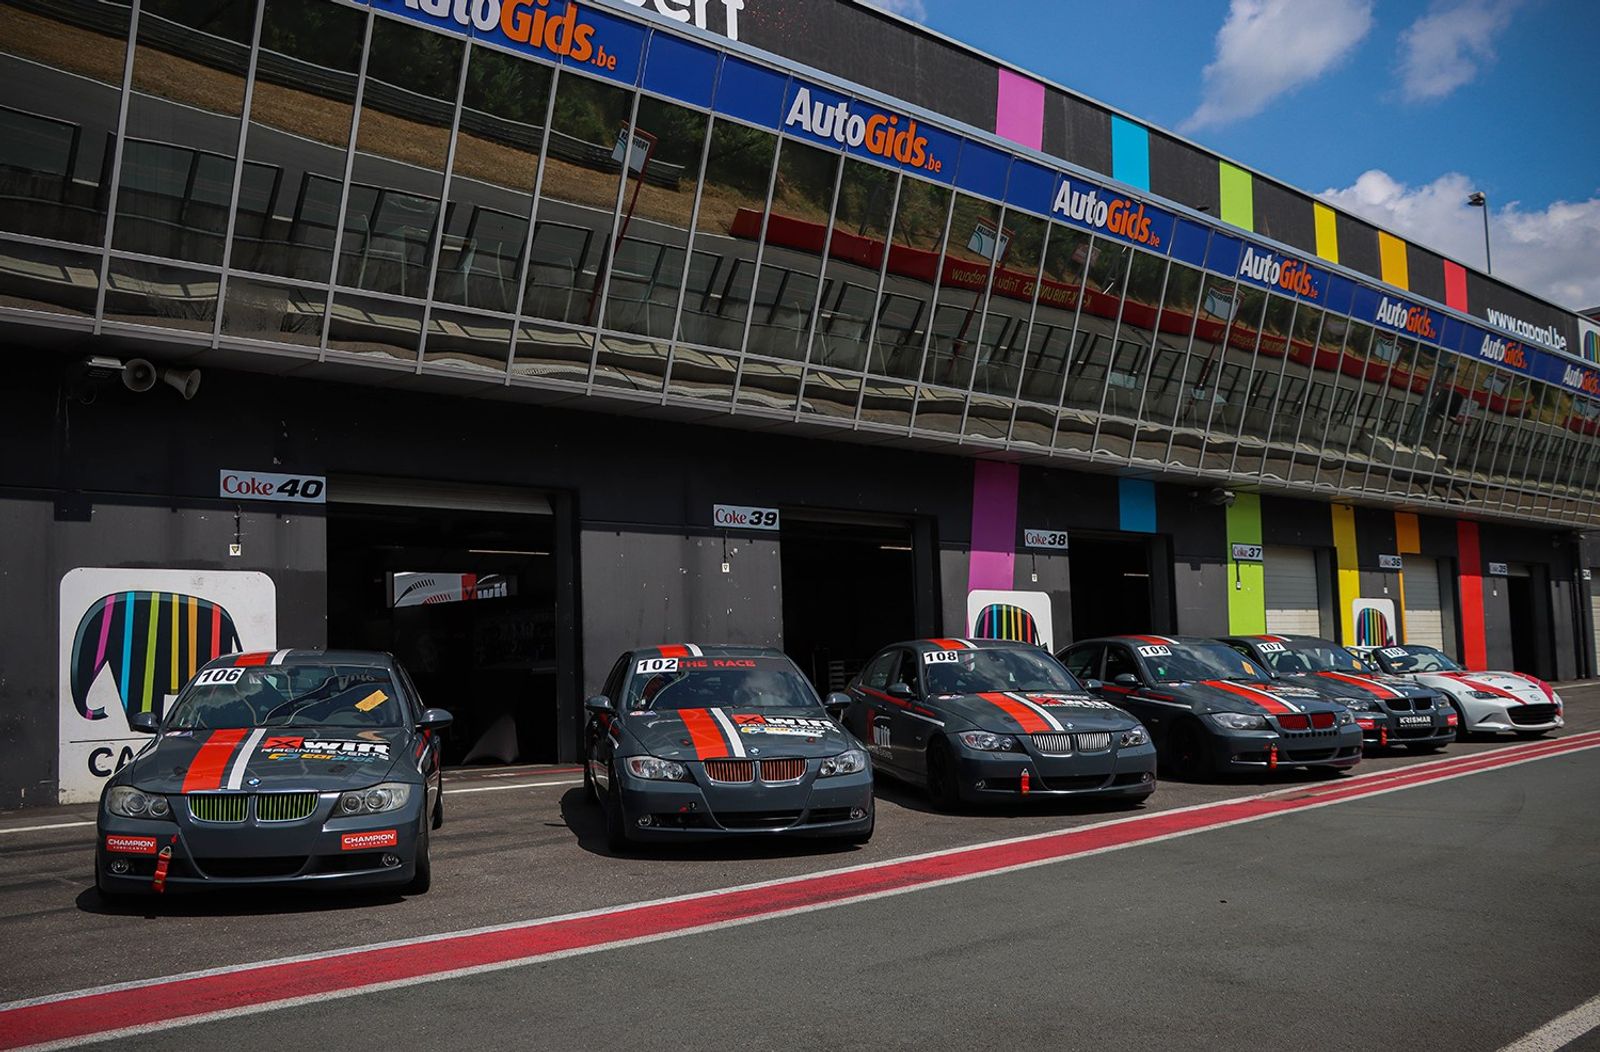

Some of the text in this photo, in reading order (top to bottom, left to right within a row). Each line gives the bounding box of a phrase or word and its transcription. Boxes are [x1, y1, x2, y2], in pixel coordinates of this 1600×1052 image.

[624, 0, 745, 41] ert
[785, 87, 943, 174] AutoGids.be
[1052, 179, 1161, 248] AutoGids.be
[222, 475, 324, 499] Coke 40
[715, 508, 778, 527] Coke 39
[1026, 532, 1067, 546] Coke 38
[1248, 547, 1262, 558] 37
[1140, 645, 1169, 655] 109
[1259, 643, 1281, 652] 107
[926, 652, 957, 662] 108
[639, 660, 678, 671] 102
[713, 660, 756, 668] RACE
[202, 669, 242, 683] 106
[1399, 716, 1431, 724] KRISMAR
[108, 838, 154, 847] CHAMPION
[344, 834, 395, 844] CHAMPION
